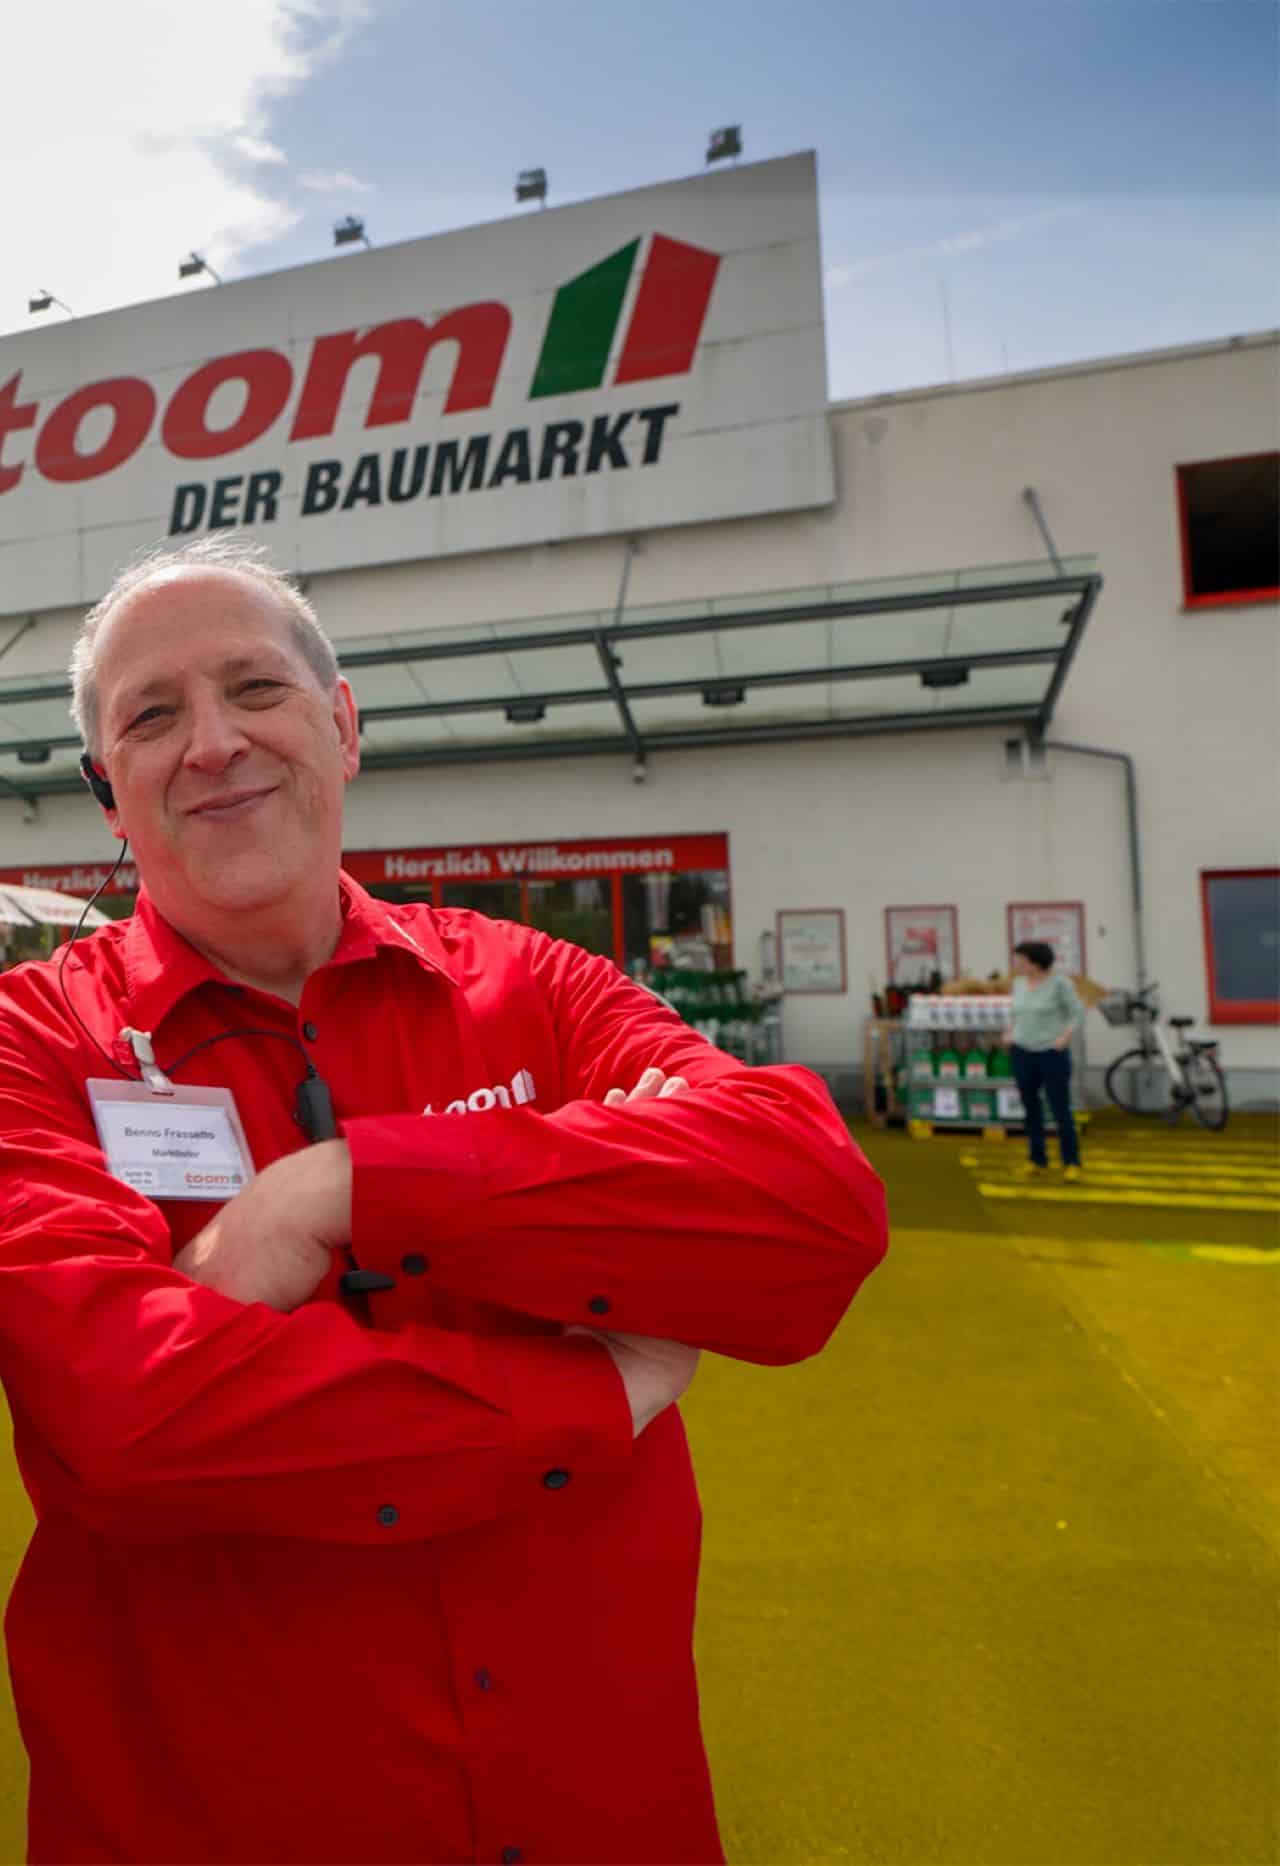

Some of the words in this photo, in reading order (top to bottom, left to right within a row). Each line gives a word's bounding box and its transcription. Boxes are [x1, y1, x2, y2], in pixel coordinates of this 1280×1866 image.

[168, 470, 283, 536] DER
[300, 403, 680, 517] BAUMARKT
[384, 850, 491, 878] Herzlich
[496, 845, 674, 874] Willkommen
[184, 1171, 231, 1185] toom
